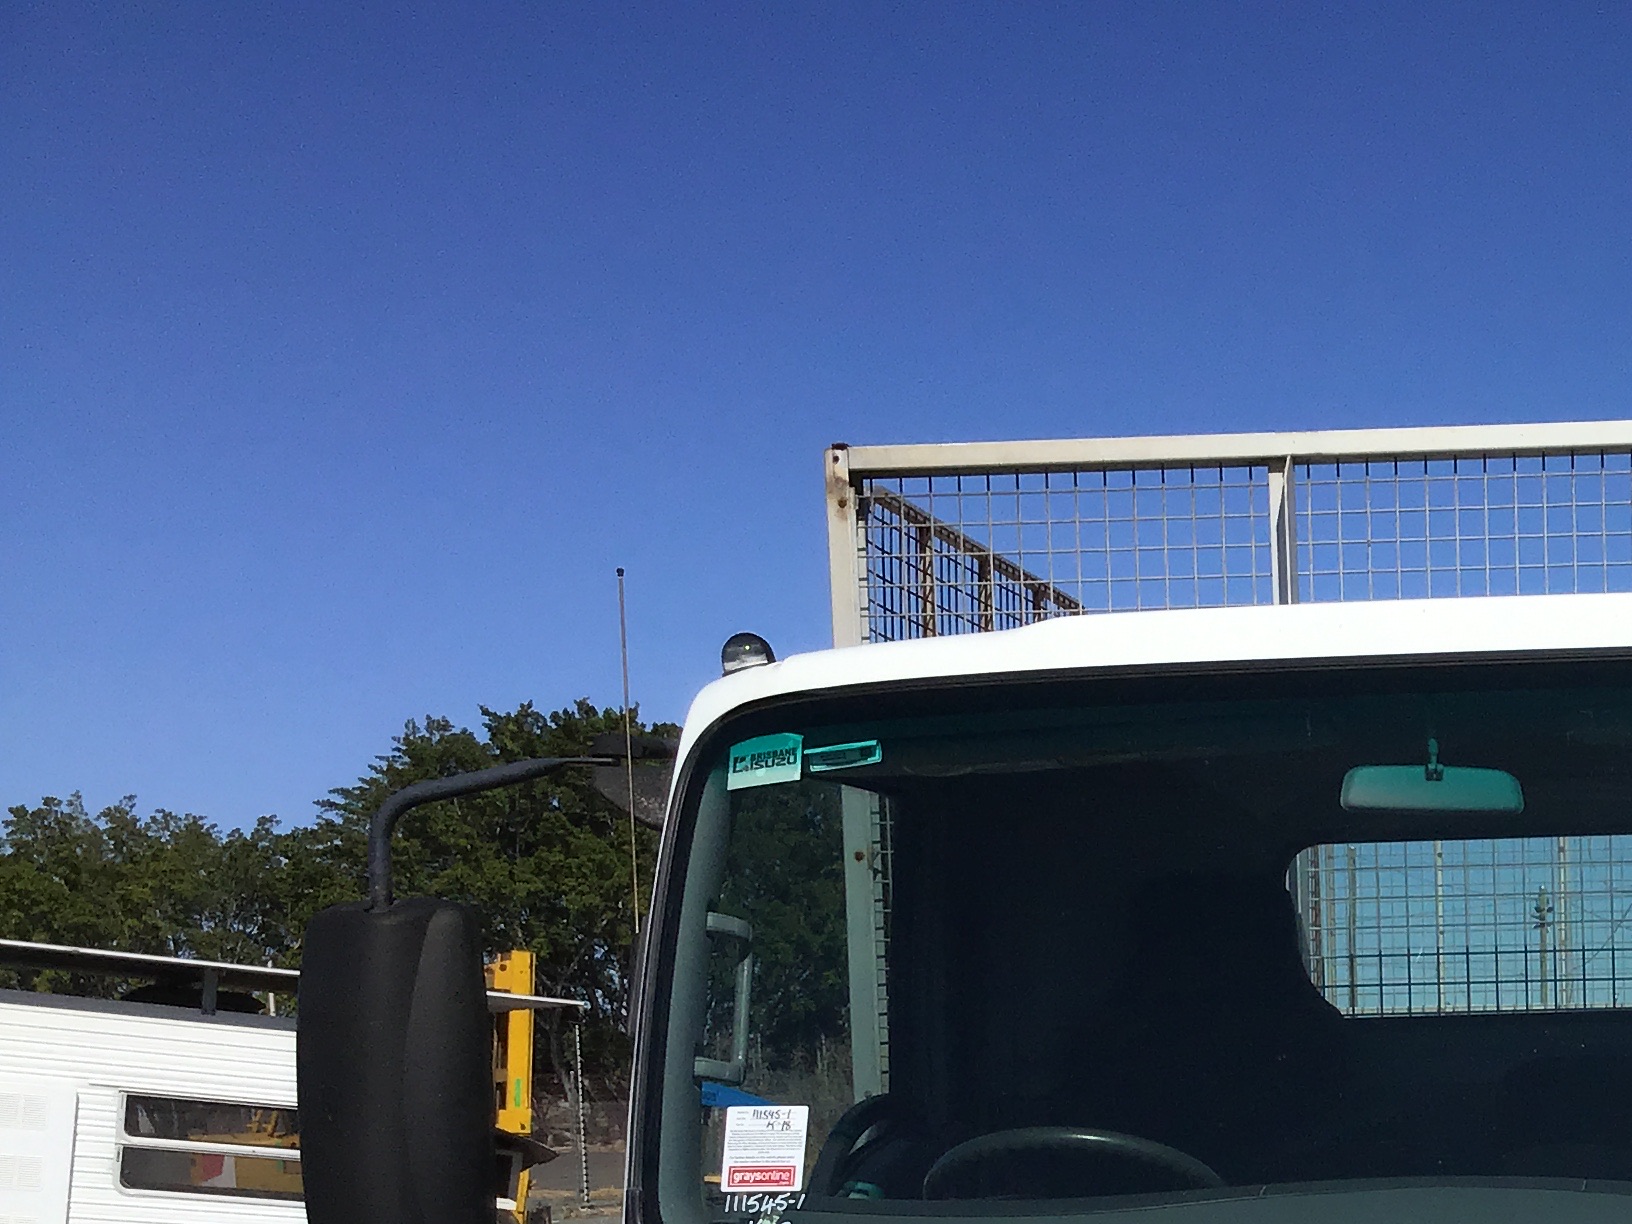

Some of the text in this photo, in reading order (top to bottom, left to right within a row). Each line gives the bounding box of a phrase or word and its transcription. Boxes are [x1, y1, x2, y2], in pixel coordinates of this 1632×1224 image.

[750, 747, 798, 762] BRISBANE
[750, 754, 798, 771] ISUZU
[733, 1170, 790, 1184] graysonline
[724, 1193, 806, 1215] 111545-1
